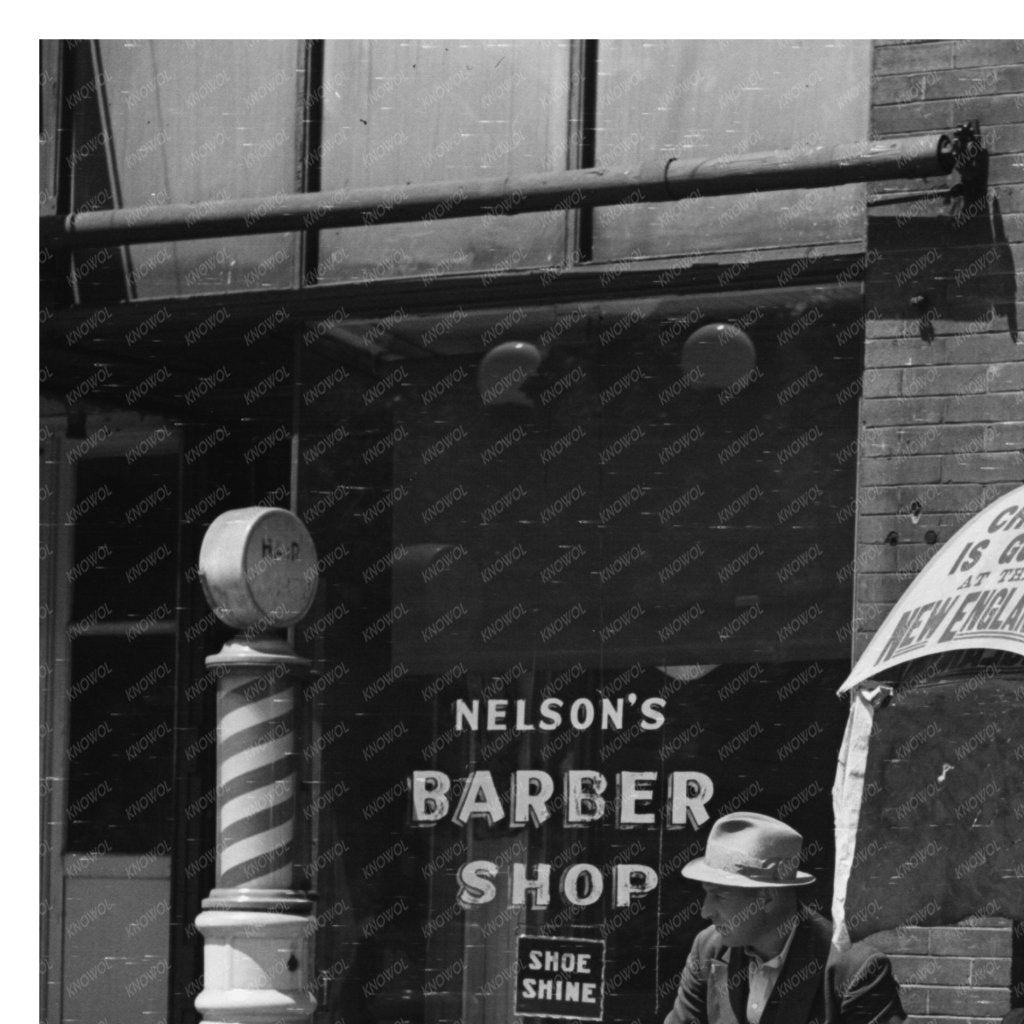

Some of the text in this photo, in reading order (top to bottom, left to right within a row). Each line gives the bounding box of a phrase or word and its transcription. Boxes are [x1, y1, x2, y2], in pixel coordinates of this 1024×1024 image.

[948, 539, 991, 576] IS
[957, 571, 992, 590] AT
[874, 595, 960, 667] NEW
[455, 692, 667, 731] NELSON'S
[409, 769, 715, 830] BARBER
[456, 860, 659, 911] SHOP
[528, 950, 591, 974] SHOE
[522, 978, 597, 1004] SHINE
